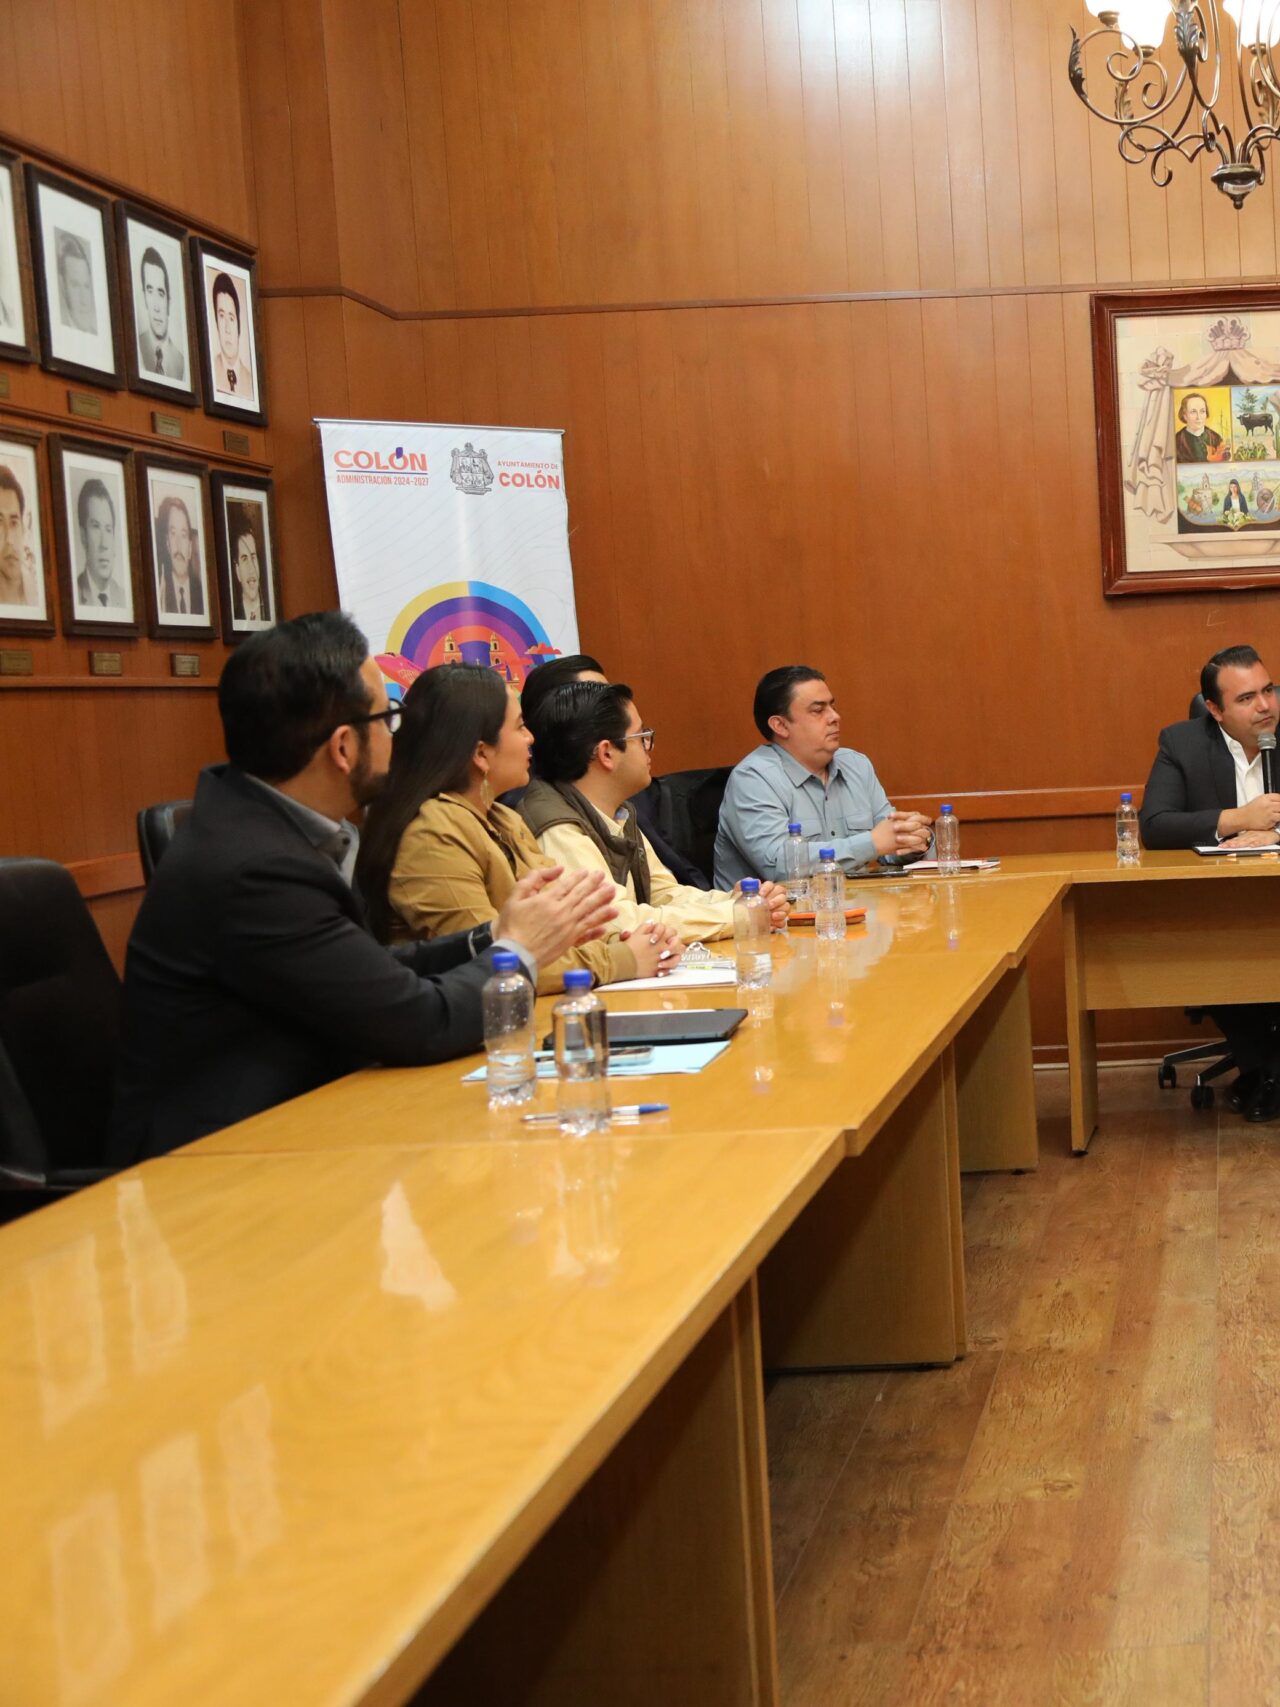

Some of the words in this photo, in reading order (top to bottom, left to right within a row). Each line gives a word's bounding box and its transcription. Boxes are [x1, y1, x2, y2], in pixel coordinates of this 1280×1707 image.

[334, 446, 428, 471] COLÓN
[497, 460, 550, 470] AYUNTAMIENTO
[336, 474, 392, 486] ADMINISTRACIÓN
[393, 476, 429, 487] 2024-2027
[498, 470, 560, 489] COLÓN
